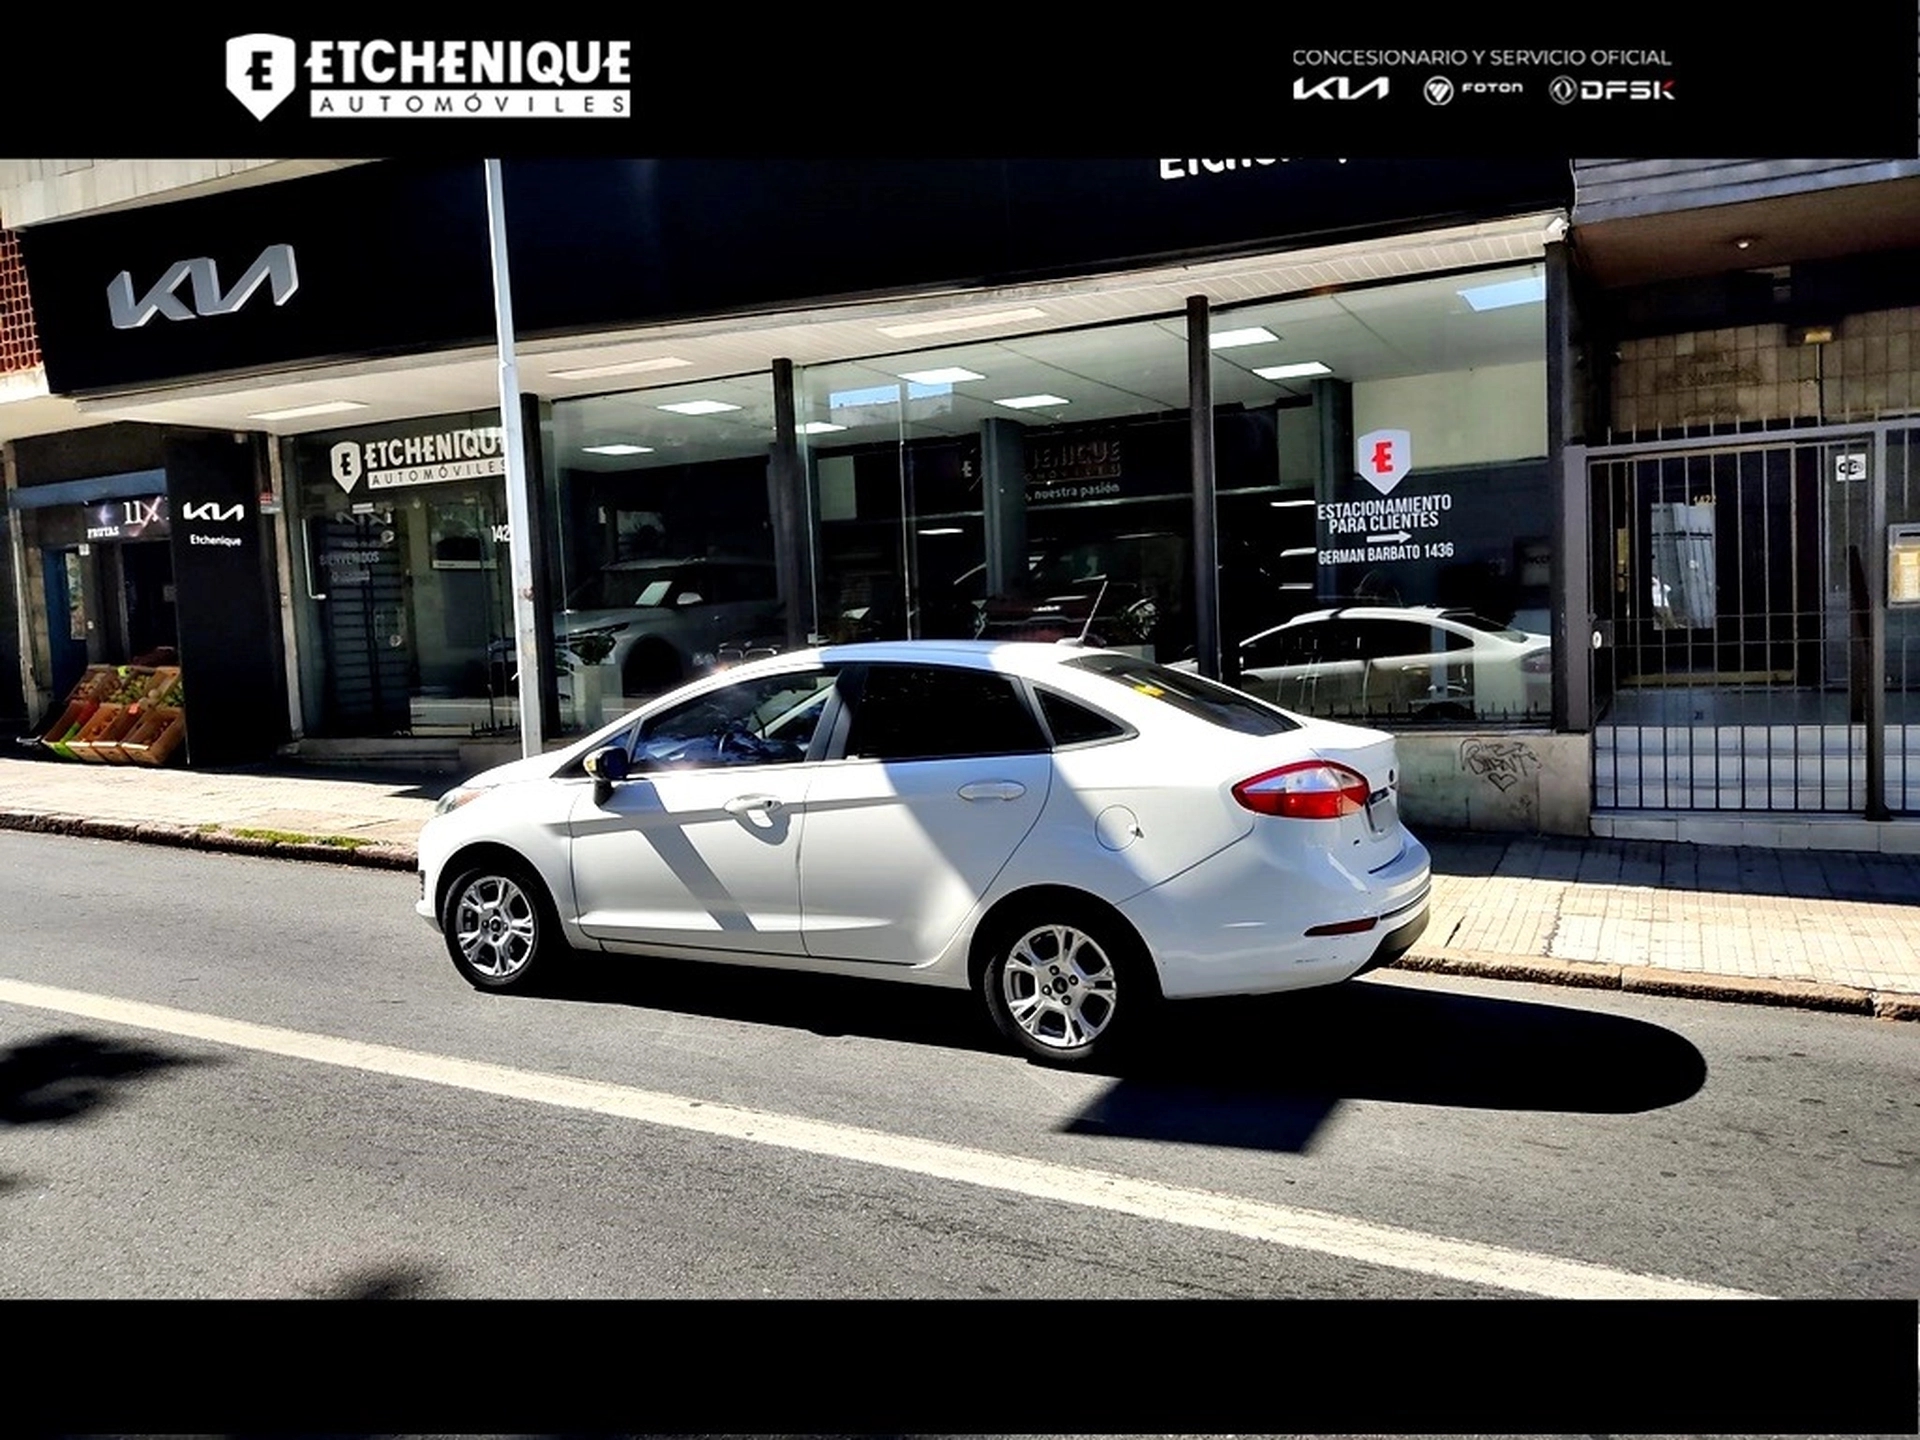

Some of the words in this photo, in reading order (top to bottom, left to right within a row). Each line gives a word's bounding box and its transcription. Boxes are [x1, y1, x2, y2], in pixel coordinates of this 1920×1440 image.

[107, 243, 299, 329] KIA
[182, 502, 245, 522] KIA
[1317, 494, 1452, 520] ESTACIONAMIENTO
[1329, 516, 1367, 534] PARA
[1370, 510, 1439, 532] CLIENTES
[189, 533, 242, 547] Etchenique
[1318, 548, 1366, 566] GERMAN
[1368, 544, 1420, 563] BARBATO
[1424, 542, 1454, 559] 1436
